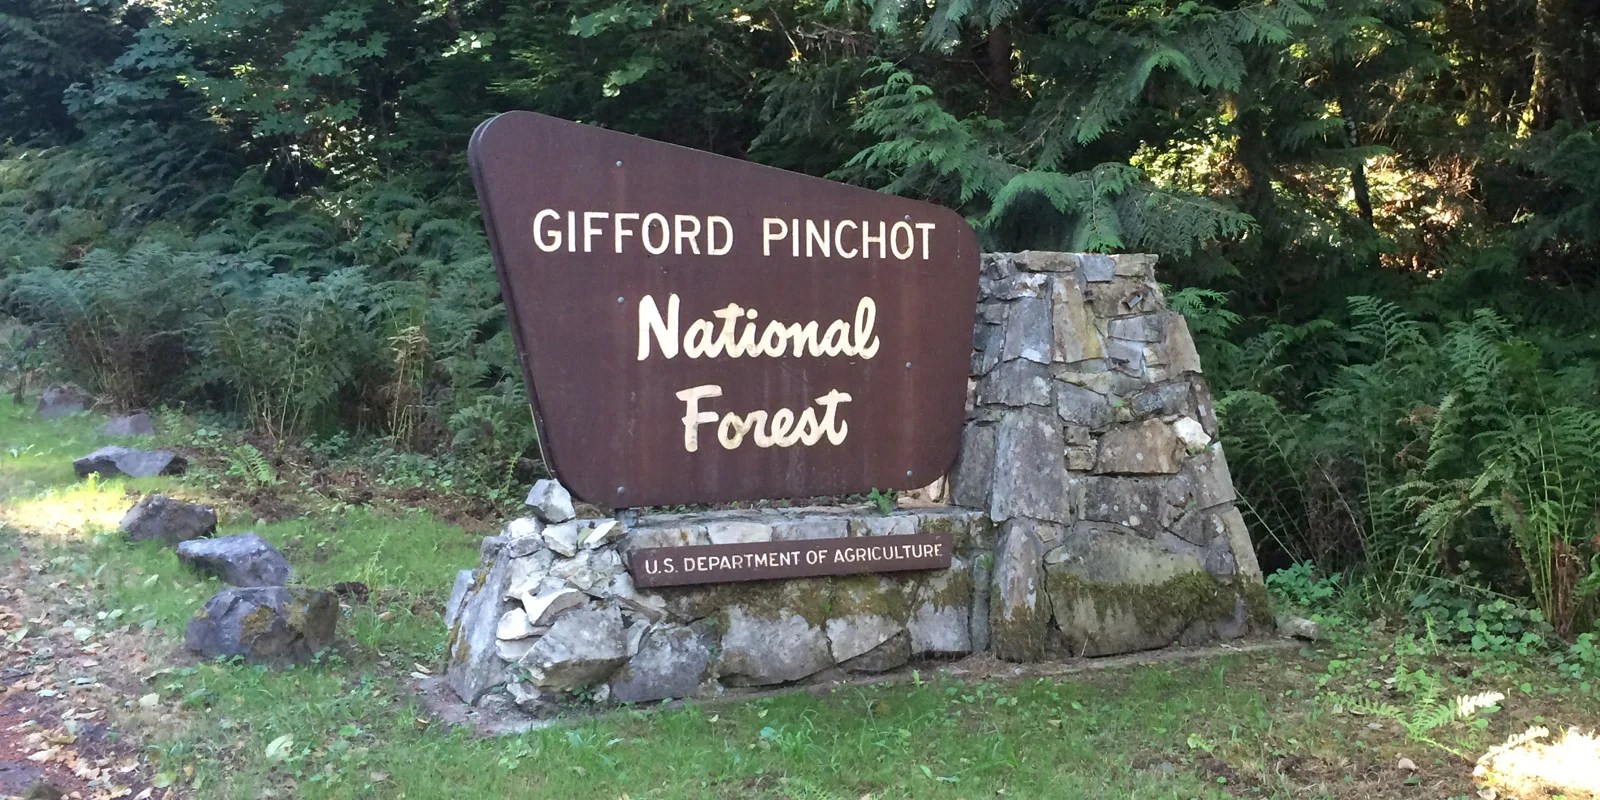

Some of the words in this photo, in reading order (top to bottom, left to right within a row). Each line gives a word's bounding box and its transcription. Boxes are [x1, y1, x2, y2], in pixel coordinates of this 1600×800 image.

[533, 209, 734, 256] GIFFORD
[762, 218, 936, 261] PINCHOT
[637, 293, 880, 361] National
[676, 385, 852, 453] Forest
[645, 558, 678, 575] U.S.
[684, 550, 800, 573] DEPARTMENT
[806, 549, 827, 565] OF
[834, 543, 943, 563] AGRICULTURE
